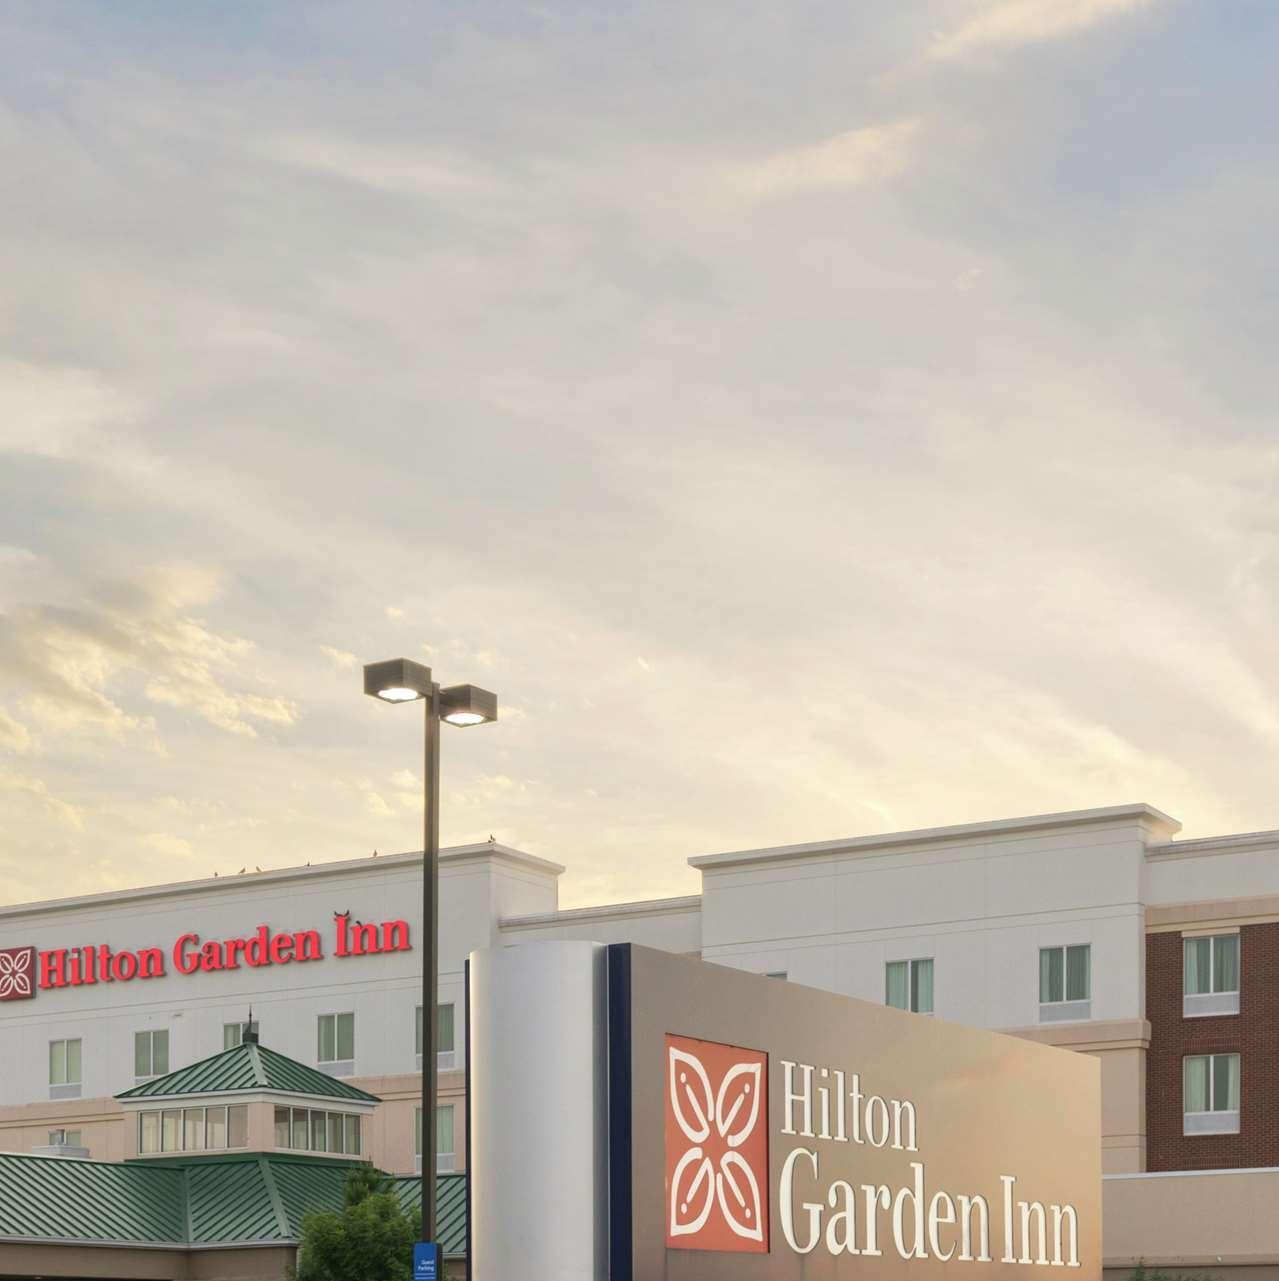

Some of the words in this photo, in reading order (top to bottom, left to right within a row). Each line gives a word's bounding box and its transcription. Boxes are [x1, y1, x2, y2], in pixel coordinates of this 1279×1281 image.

[38, 944, 167, 990] Hilton
[173, 925, 322, 974] Garden
[334, 914, 411, 957] Inn
[780, 1060, 919, 1152] Hilton
[779, 1147, 993, 1262] Garden
[1000, 1175, 1081, 1267] Inn
